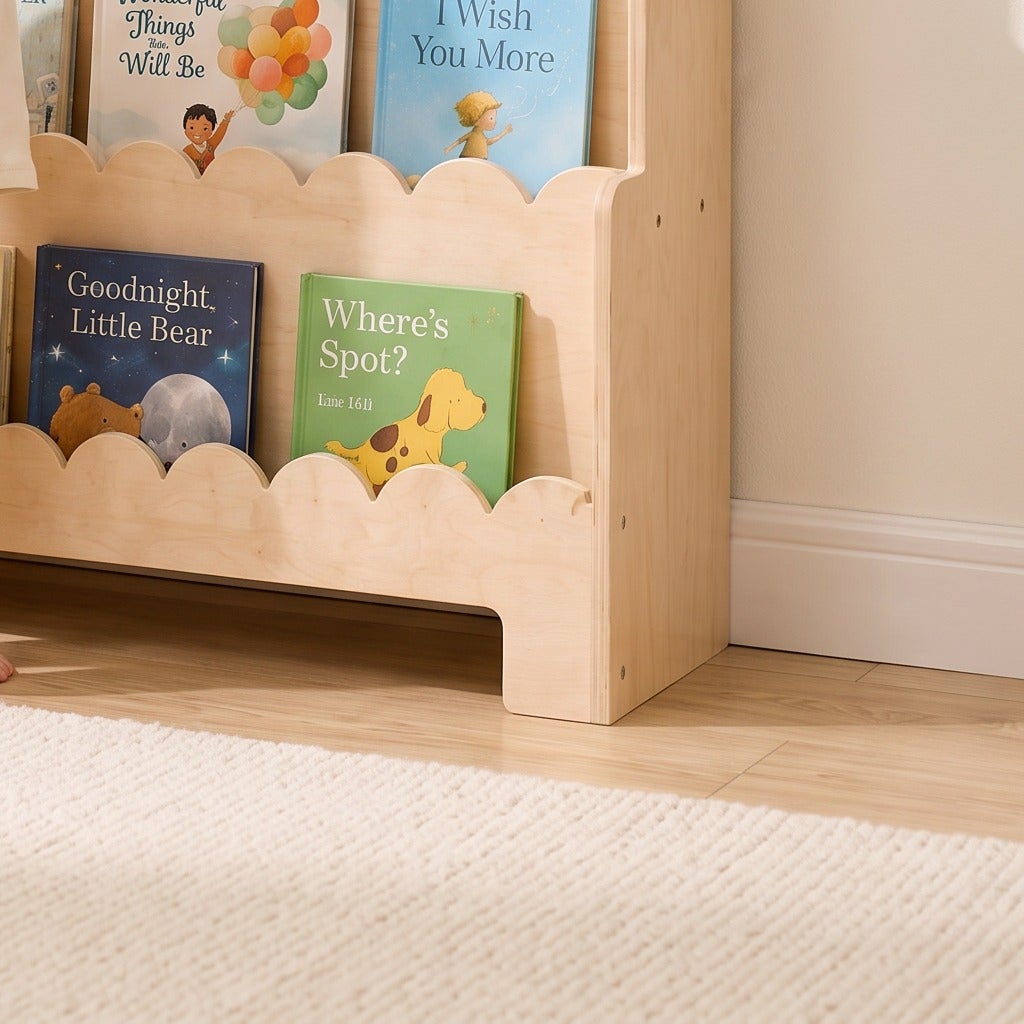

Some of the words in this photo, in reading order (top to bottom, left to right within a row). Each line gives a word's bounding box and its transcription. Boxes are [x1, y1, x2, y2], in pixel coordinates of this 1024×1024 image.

[125, 9, 195, 46] Things
[119, 50, 170, 77] Will
[176, 54, 206, 78] Be
[411, 34, 466, 68] You
[475, 38, 555, 73] More
[70, 307, 142, 339] Little
[149, 315, 213, 347] Bear
[319, 339, 408, 378] Spot?
